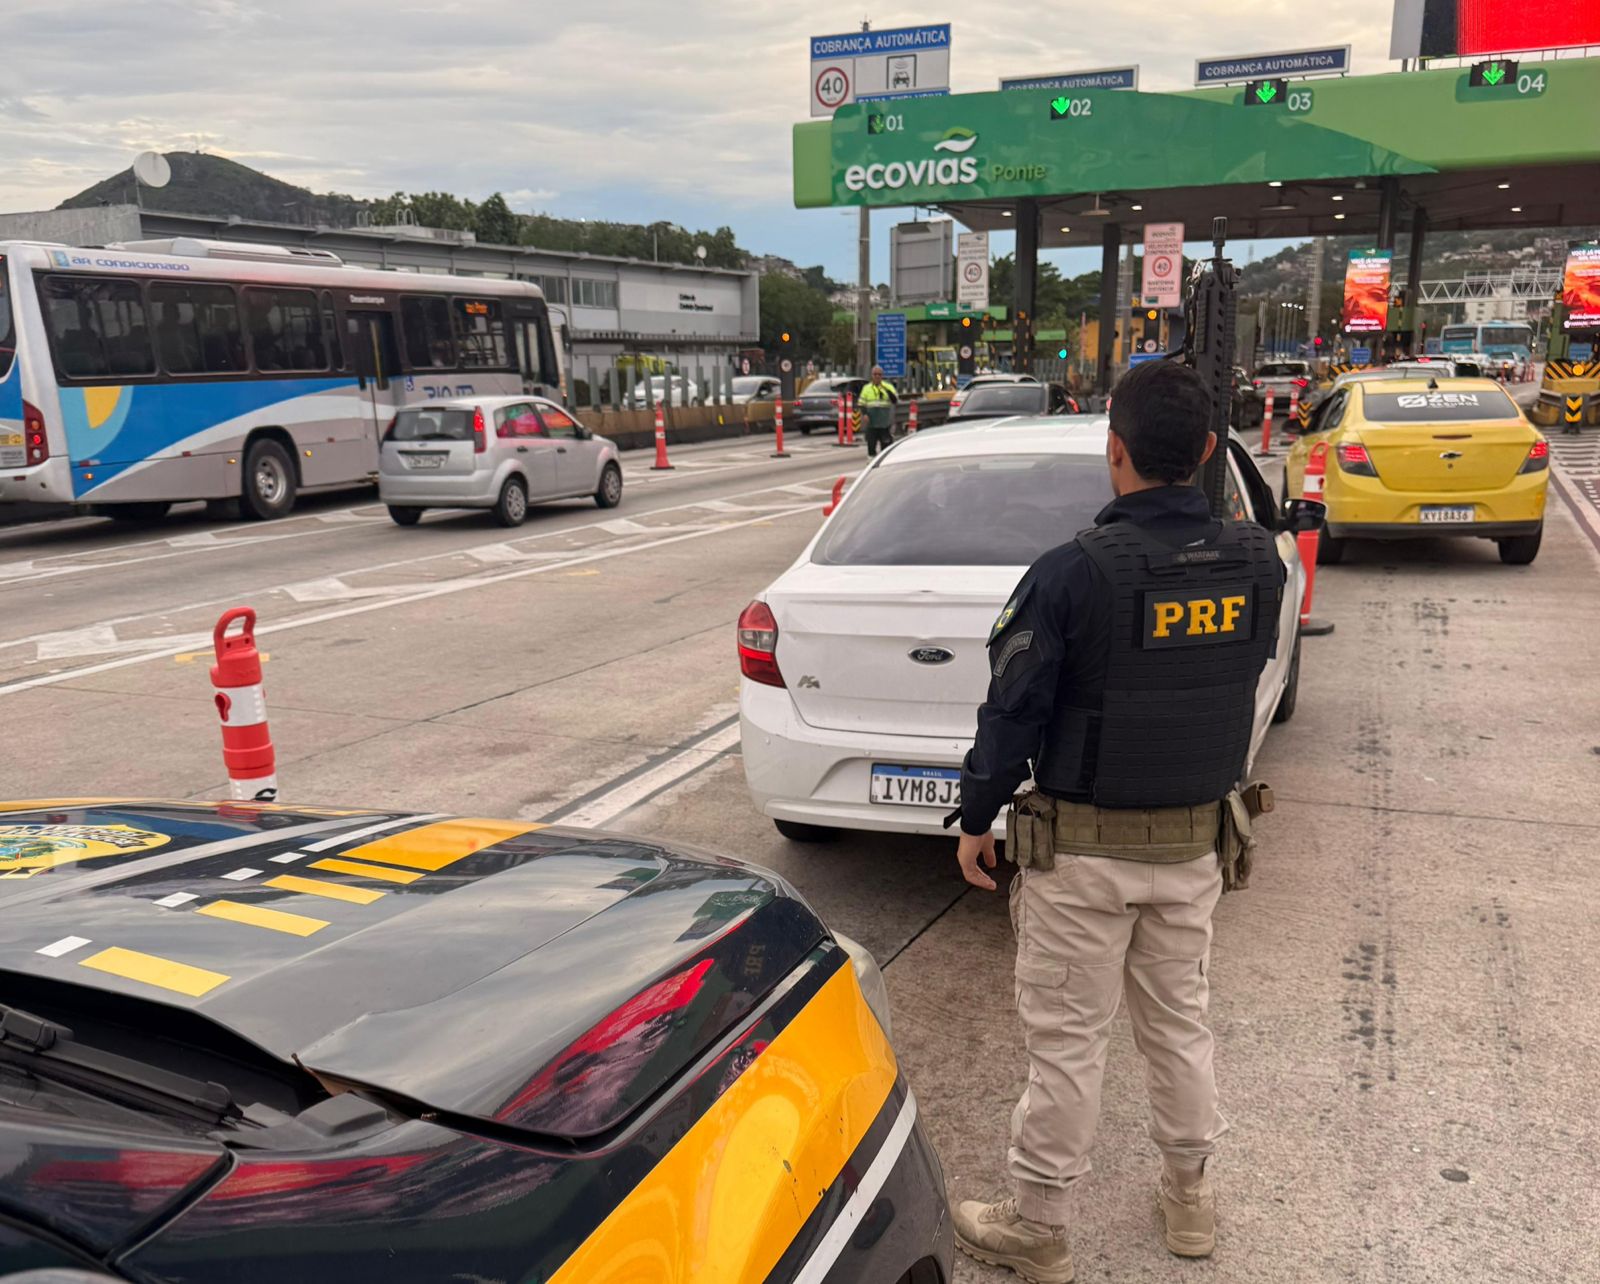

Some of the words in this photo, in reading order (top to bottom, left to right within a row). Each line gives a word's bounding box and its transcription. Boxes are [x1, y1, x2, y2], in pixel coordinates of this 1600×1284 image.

[813, 37, 872, 54] COBRANÇA
[875, 30, 946, 48] AUTOMÁTICA
[1265, 55, 1334, 71] AUTOMÁTICA
[821, 77, 843, 95] 40
[1517, 74, 1545, 93] 04
[1070, 98, 1092, 116] 02
[1288, 92, 1312, 111] 03
[886, 115, 904, 131] 01
[844, 156, 978, 191] ecovias
[992, 163, 1046, 182] Ponte
[1427, 394, 1478, 403] ZEN
[1152, 595, 1245, 637] PRF
[917, 650, 944, 661] Ford
